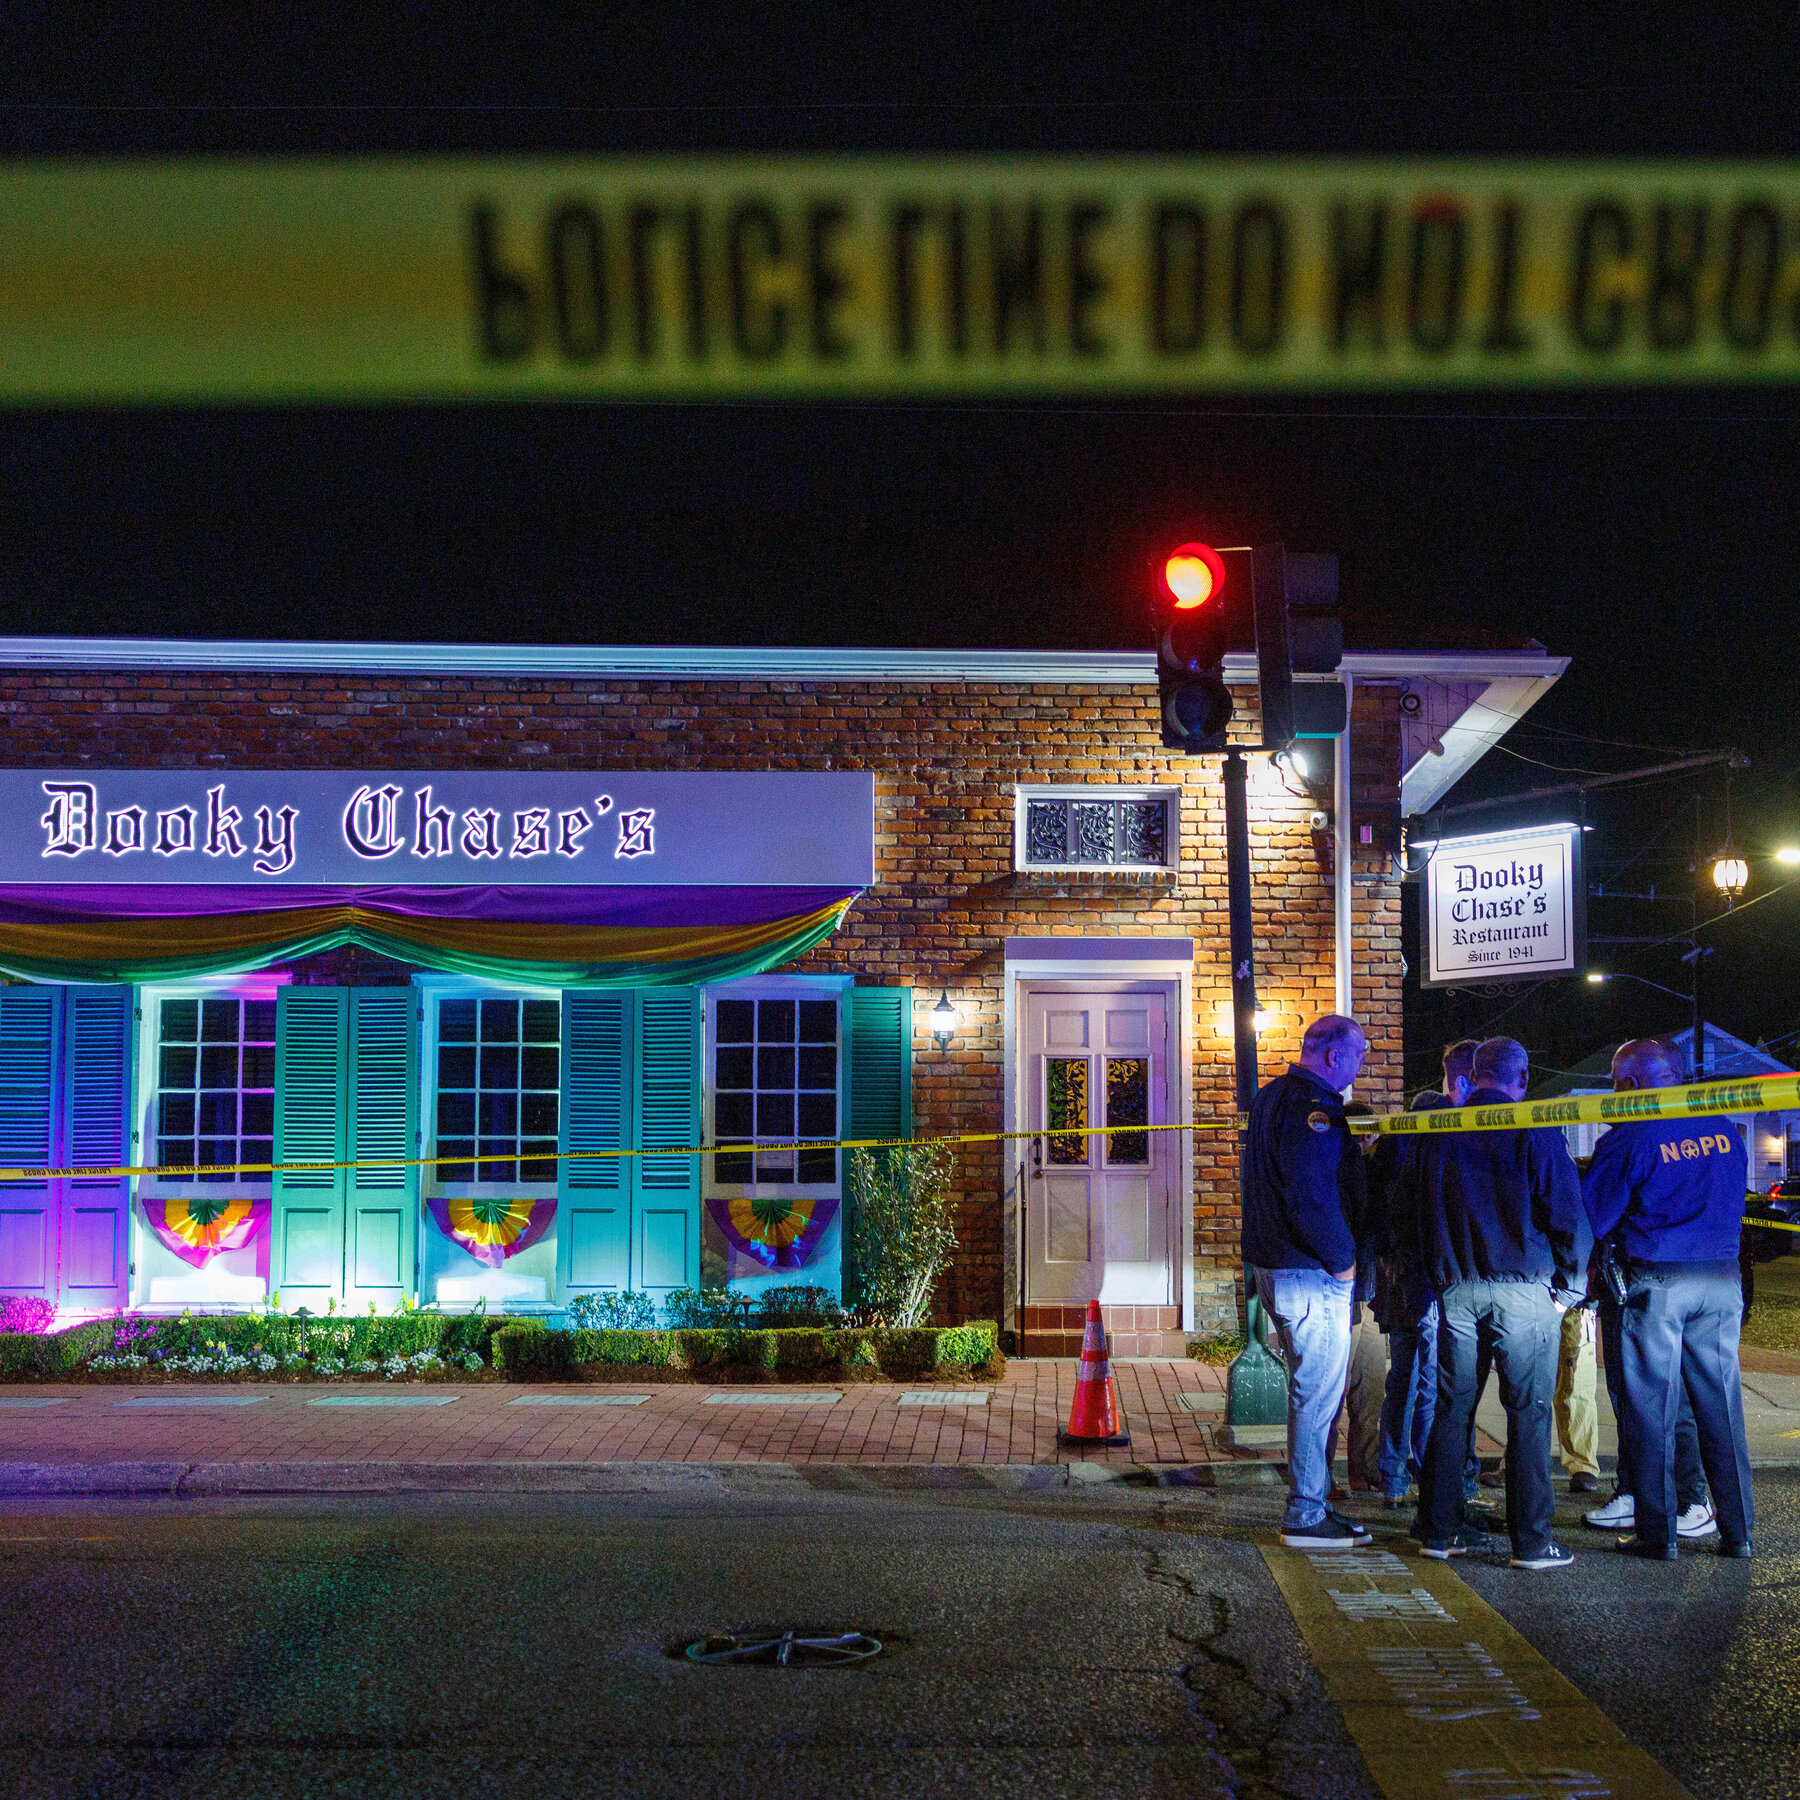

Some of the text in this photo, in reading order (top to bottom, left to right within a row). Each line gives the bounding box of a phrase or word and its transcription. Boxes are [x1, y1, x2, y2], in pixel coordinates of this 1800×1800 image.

[42, 781, 656, 875] Dooky Chase's
[1453, 860, 1543, 892] Dooky
[1452, 891, 1547, 922] Chase's
[1452, 921, 1549, 946] Restaurant
[1468, 945, 1533, 963] Since 1941
